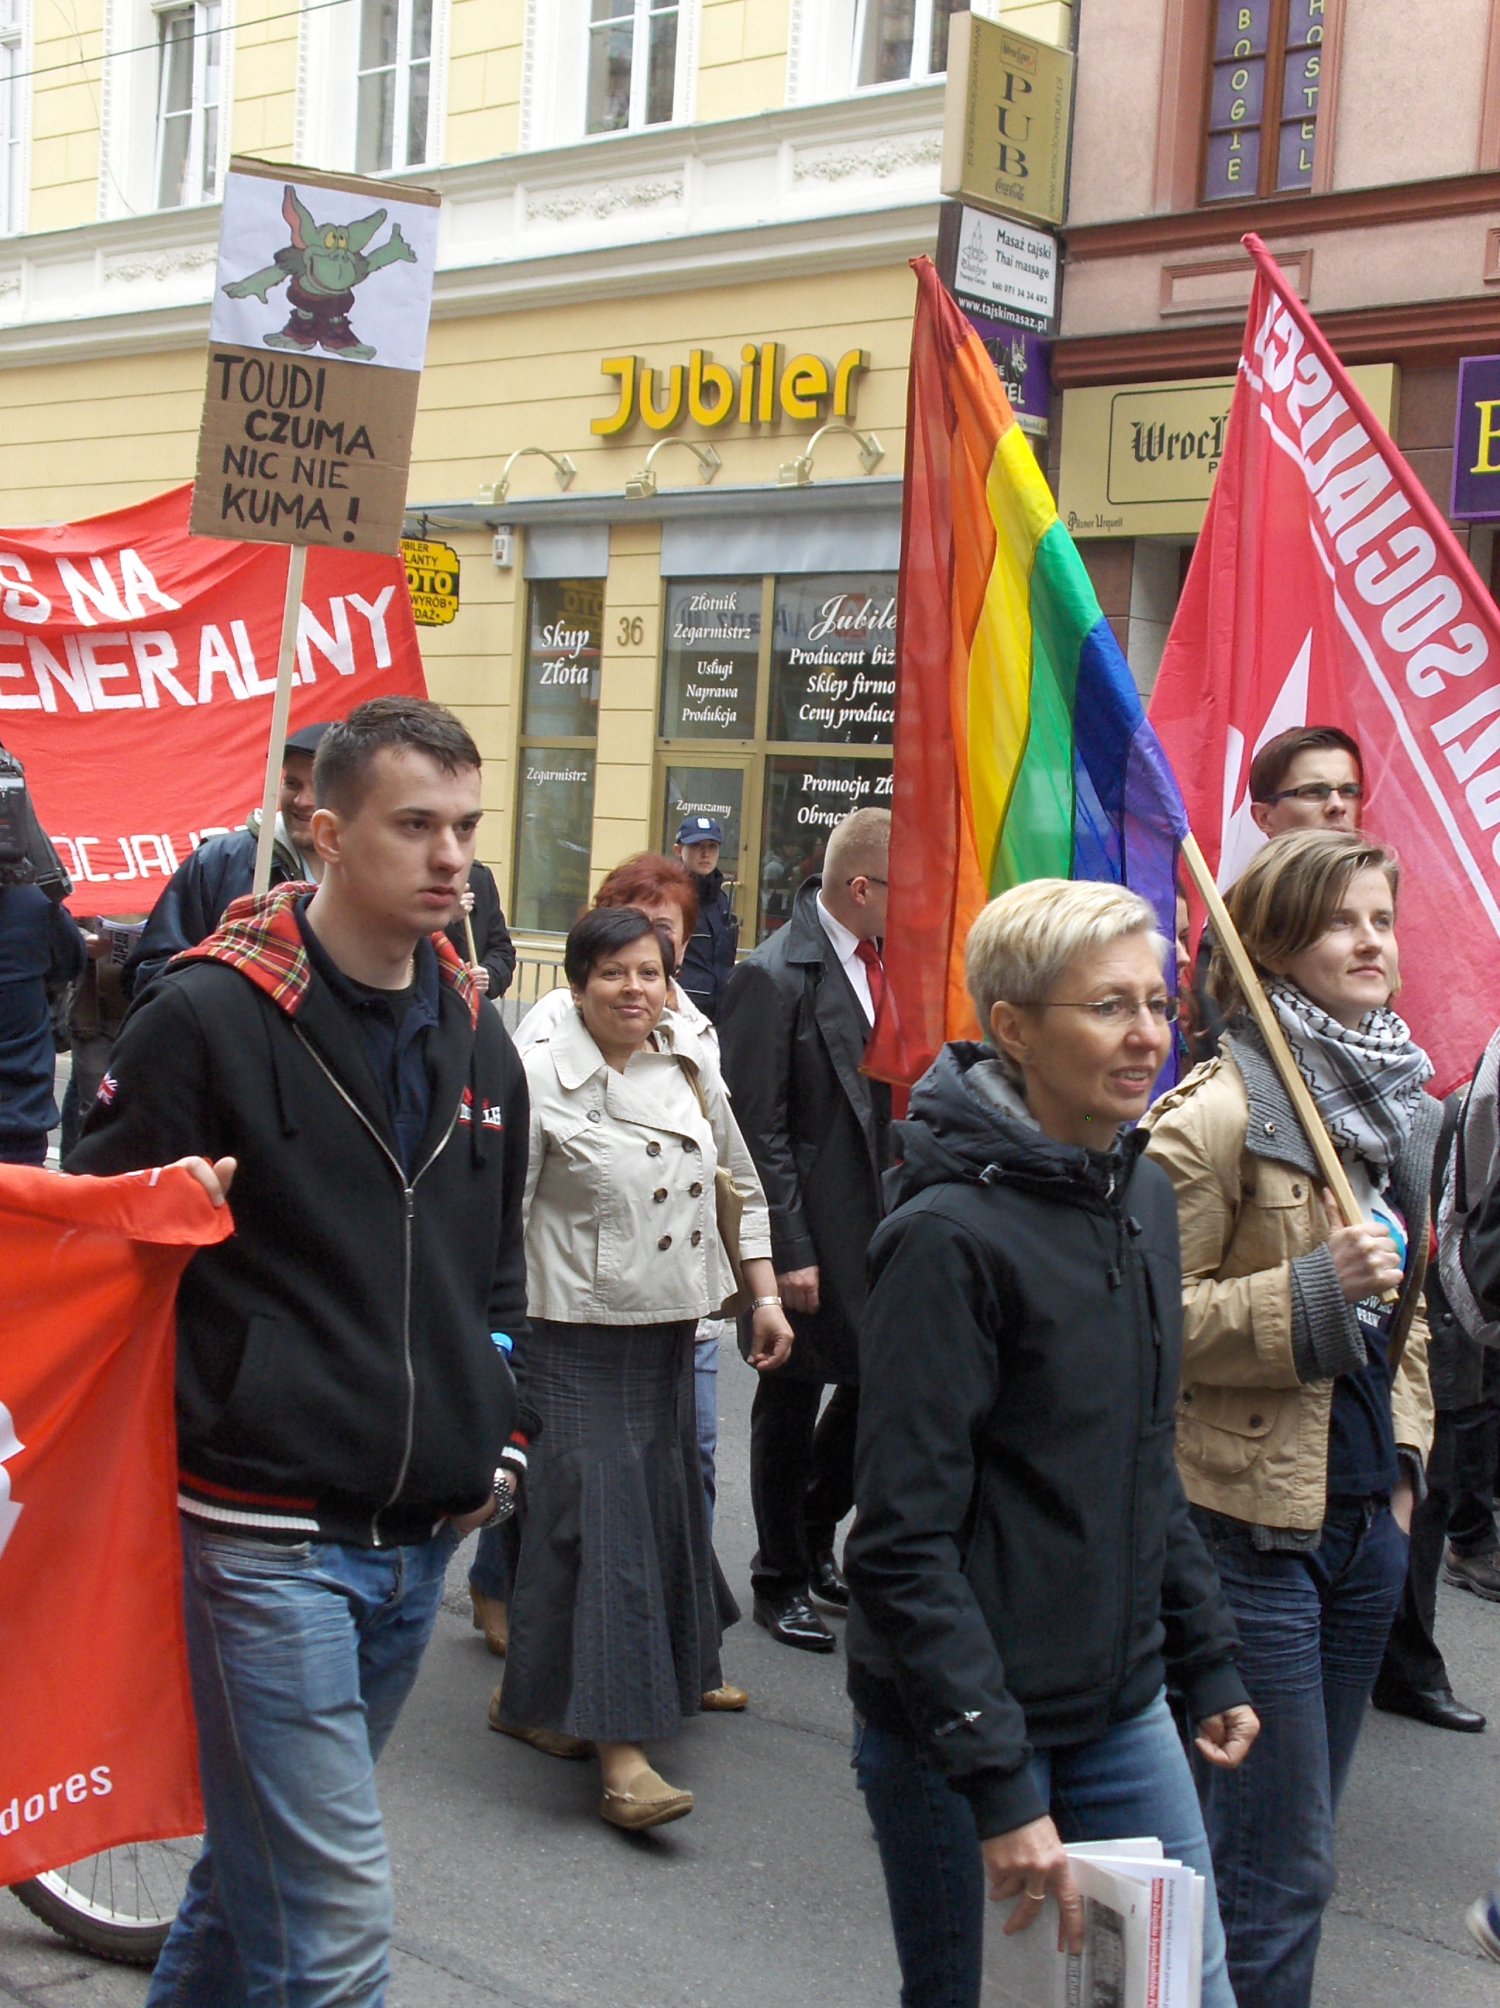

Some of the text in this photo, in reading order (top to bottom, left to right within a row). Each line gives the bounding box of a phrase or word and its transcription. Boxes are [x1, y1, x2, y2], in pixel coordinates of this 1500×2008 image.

[1227, 9, 1251, 180] BOOGIE
[995, 70, 1033, 178] PUB
[996, 229, 1052, 260] Masaż tajski
[995, 249, 1013, 267] Thai
[1015, 260, 1050, 280] massage
[958, 297, 1047, 333] www.tajskimasaz.pl
[213, 353, 326, 412] TOUDI
[590, 342, 868, 436] Jubiler
[244, 409, 375, 459] CZUMA
[1131, 408, 1231, 463] WrocL
[222, 444, 350, 489] NIC NIE
[221, 483, 332, 533] KUMA
[55, 548, 182, 626] NA
[689, 592, 738, 611] Złotnik
[541, 620, 590, 659] Skup
[616, 616, 644, 647] 36
[673, 623, 751, 646] Zegarmistrz
[697, 658, 733, 681] Usługi
[788, 644, 896, 665] Producent biż
[540, 657, 590, 685] Złota
[806, 672, 896, 701] Sklep firmo
[686, 684, 739, 704] Naprawa
[682, 705, 738, 728] Produkcja
[799, 702, 895, 729] Ceny produce
[526, 767, 588, 785] Zegarmistrz
[801, 774, 870, 800] Promocja
[676, 799, 732, 817] Zapraszamy
[0, 1765, 113, 1836] dores
